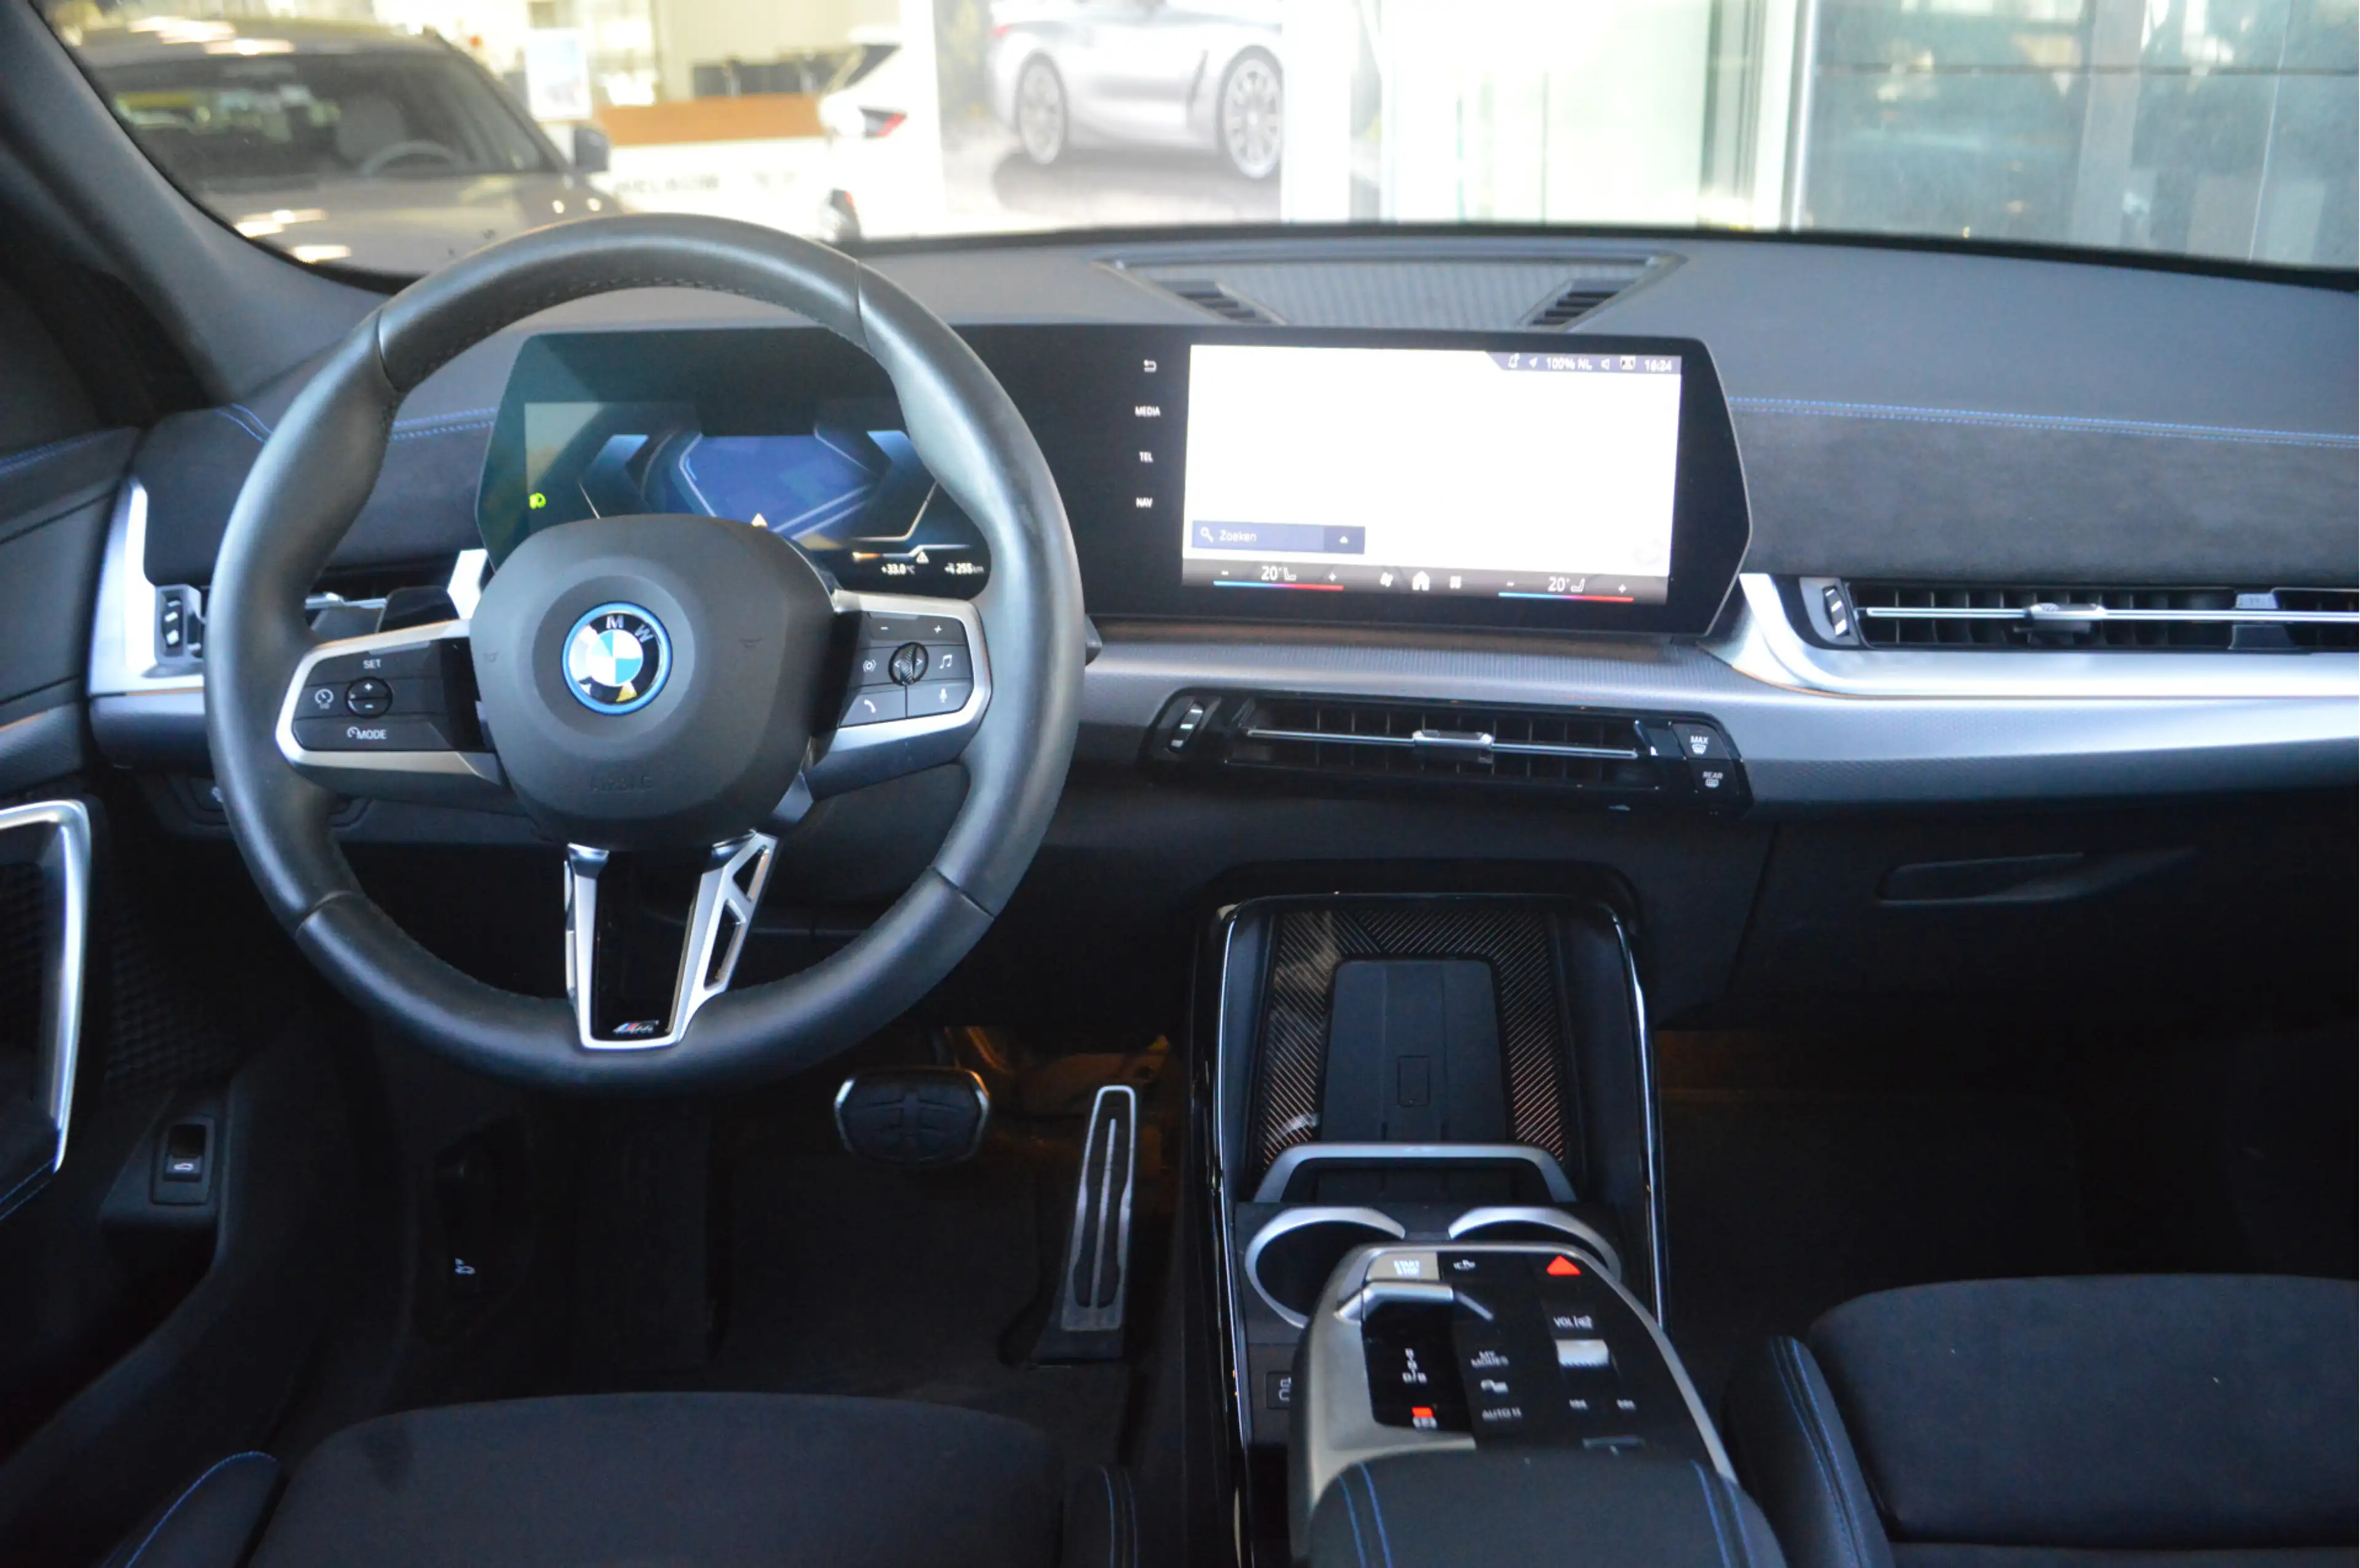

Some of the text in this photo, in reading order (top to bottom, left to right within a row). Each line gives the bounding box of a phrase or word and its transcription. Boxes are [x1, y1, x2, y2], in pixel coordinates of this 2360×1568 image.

[1135, 406, 1161, 417] MEDIA
[1139, 451, 1154, 463] TEL
[1136, 497, 1153, 509] NAV
[1219, 530, 1257, 542] Zoeken
[363, 659, 382, 668] SET
[356, 729, 387, 739] MODE
[1690, 735, 1709, 745] MAX
[1702, 771, 1723, 780] REAR
